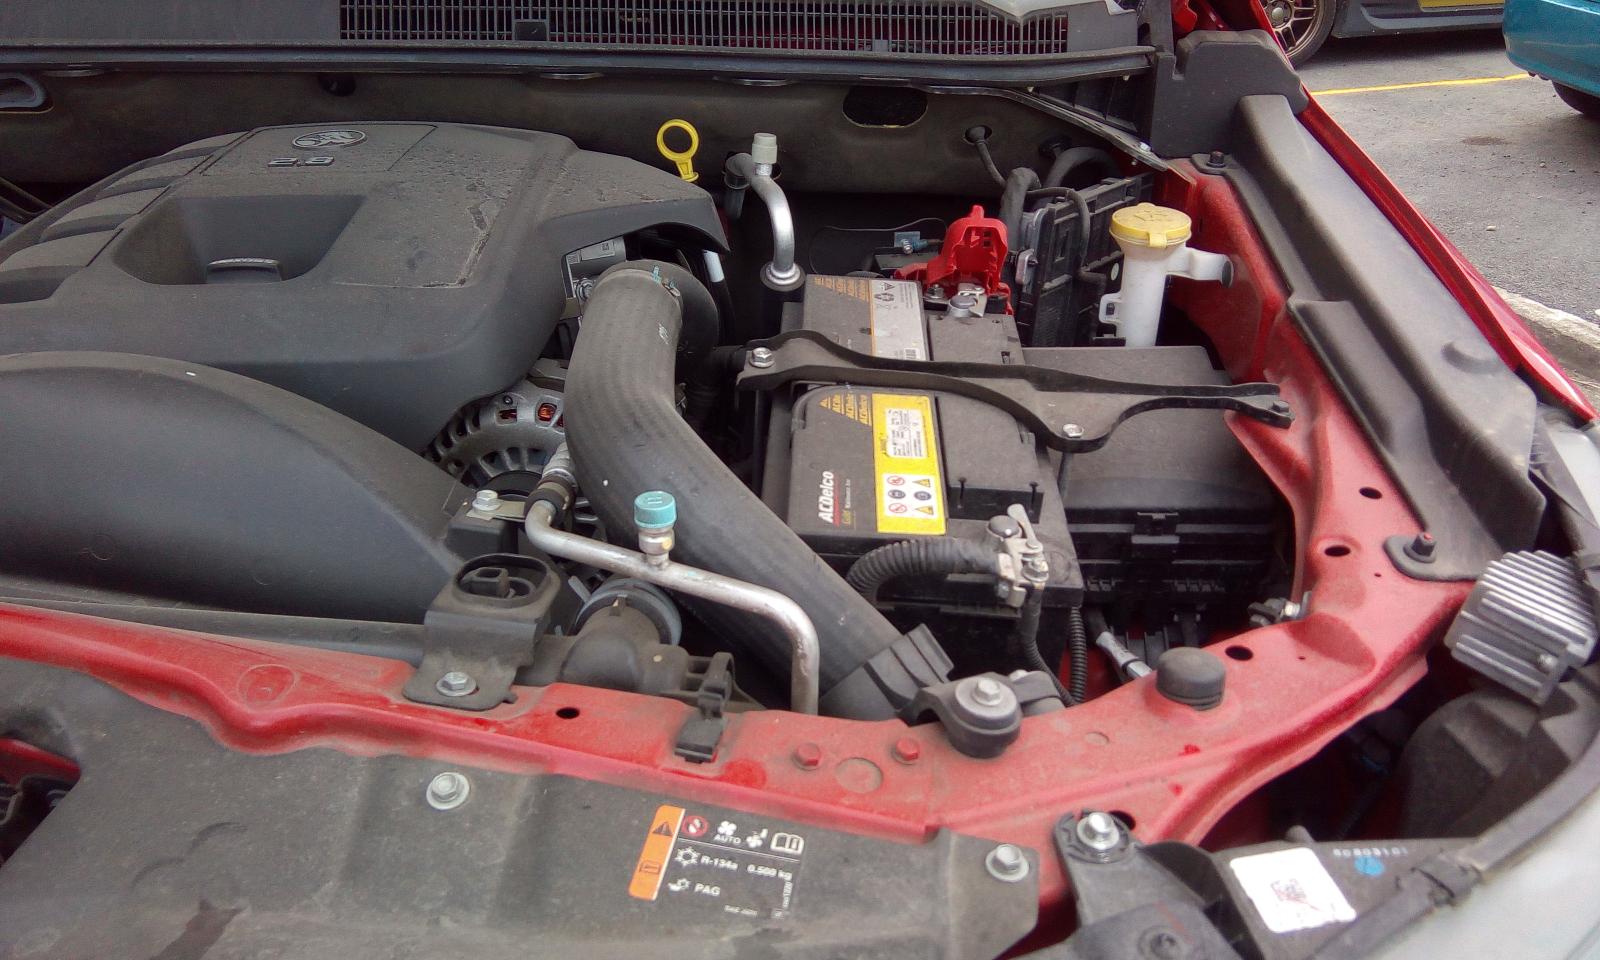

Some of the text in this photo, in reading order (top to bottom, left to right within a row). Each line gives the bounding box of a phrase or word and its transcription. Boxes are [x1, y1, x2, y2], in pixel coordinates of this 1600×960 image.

[818, 470, 834, 524] ACDelco
[714, 834, 741, 845] AUTO
[701, 855, 738, 871] R-134a
[778, 869, 792, 881] kg
[694, 882, 721, 897] PAG
